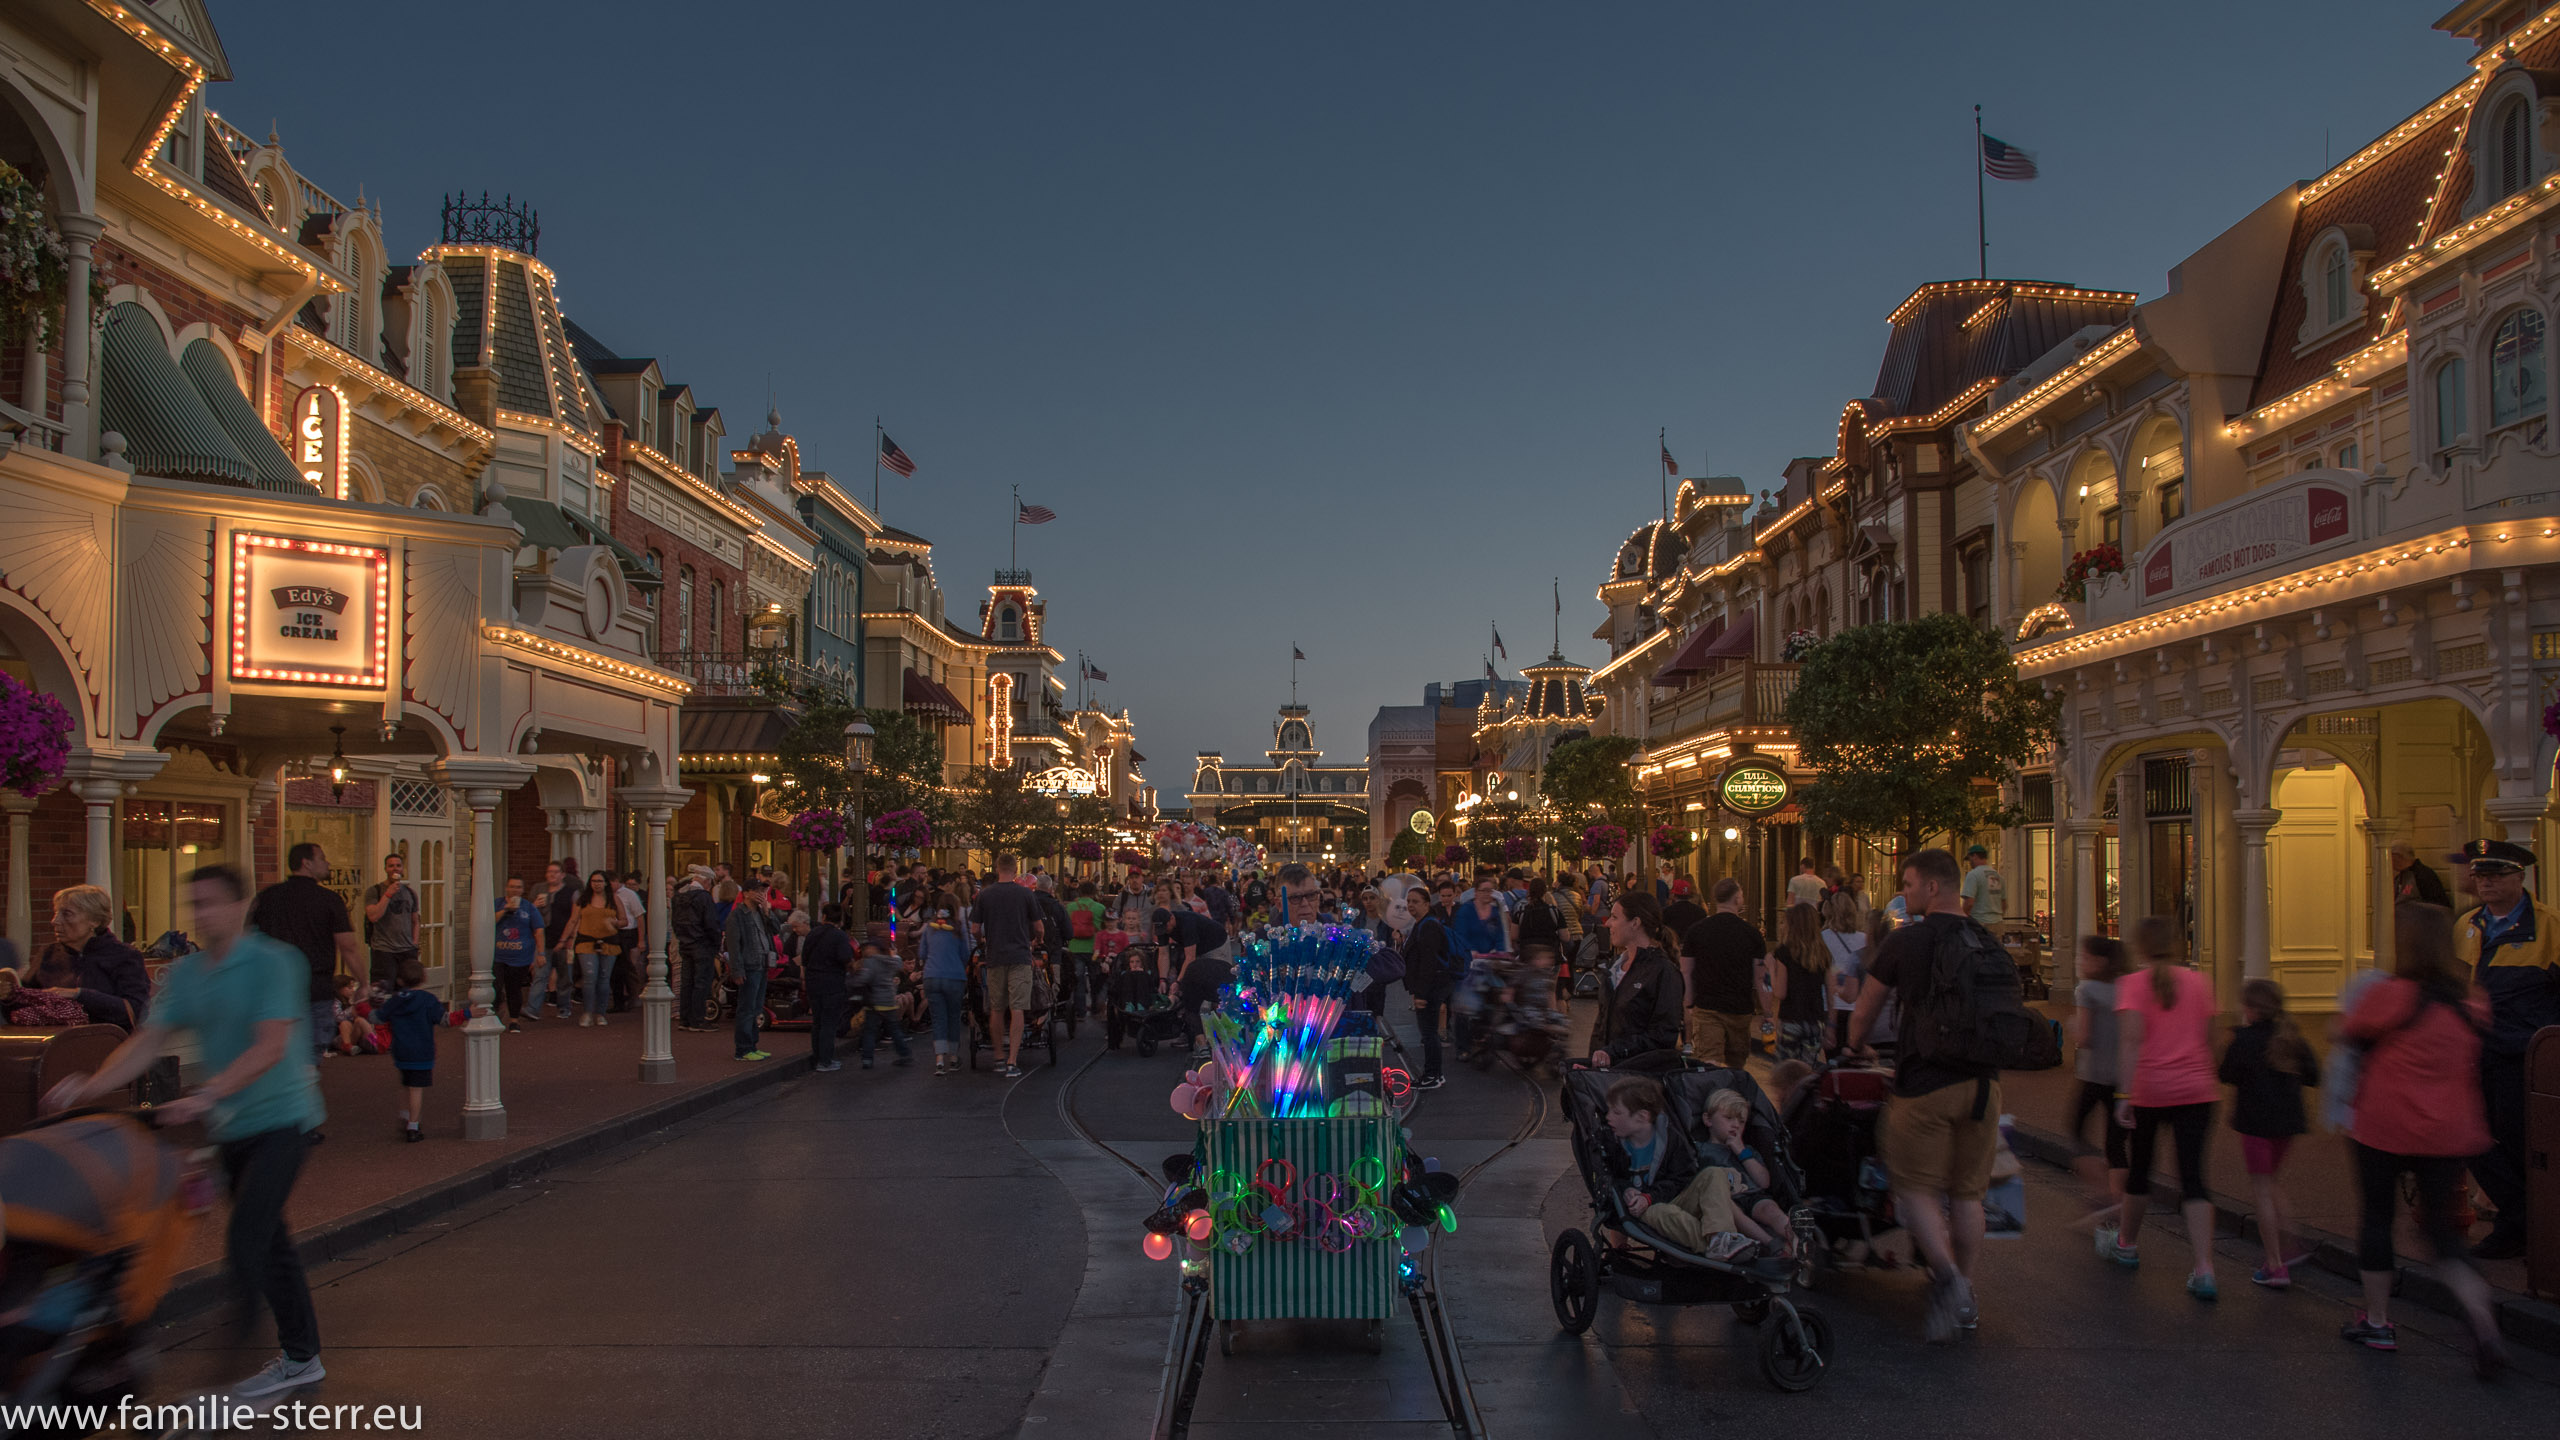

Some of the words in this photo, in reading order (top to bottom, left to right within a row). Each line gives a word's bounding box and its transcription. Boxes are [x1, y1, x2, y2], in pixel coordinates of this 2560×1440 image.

[302, 393, 324, 463] ICE
[2174, 516, 2234, 581] CASEY'S
[2238, 496, 2308, 546] CORNER
[2199, 553, 2232, 580] FAMOUS
[2234, 547, 2250, 569] HOT
[2252, 543, 2276, 563] DOGS
[287, 589, 334, 606] Edy's
[296, 612, 323, 626] ICE
[280, 625, 338, 641] CREAM
[997, 687, 1006, 729] CRYSTAL
[1743, 772, 1769, 780] HALL
[1727, 784, 1784, 793] CHAMPIONS
